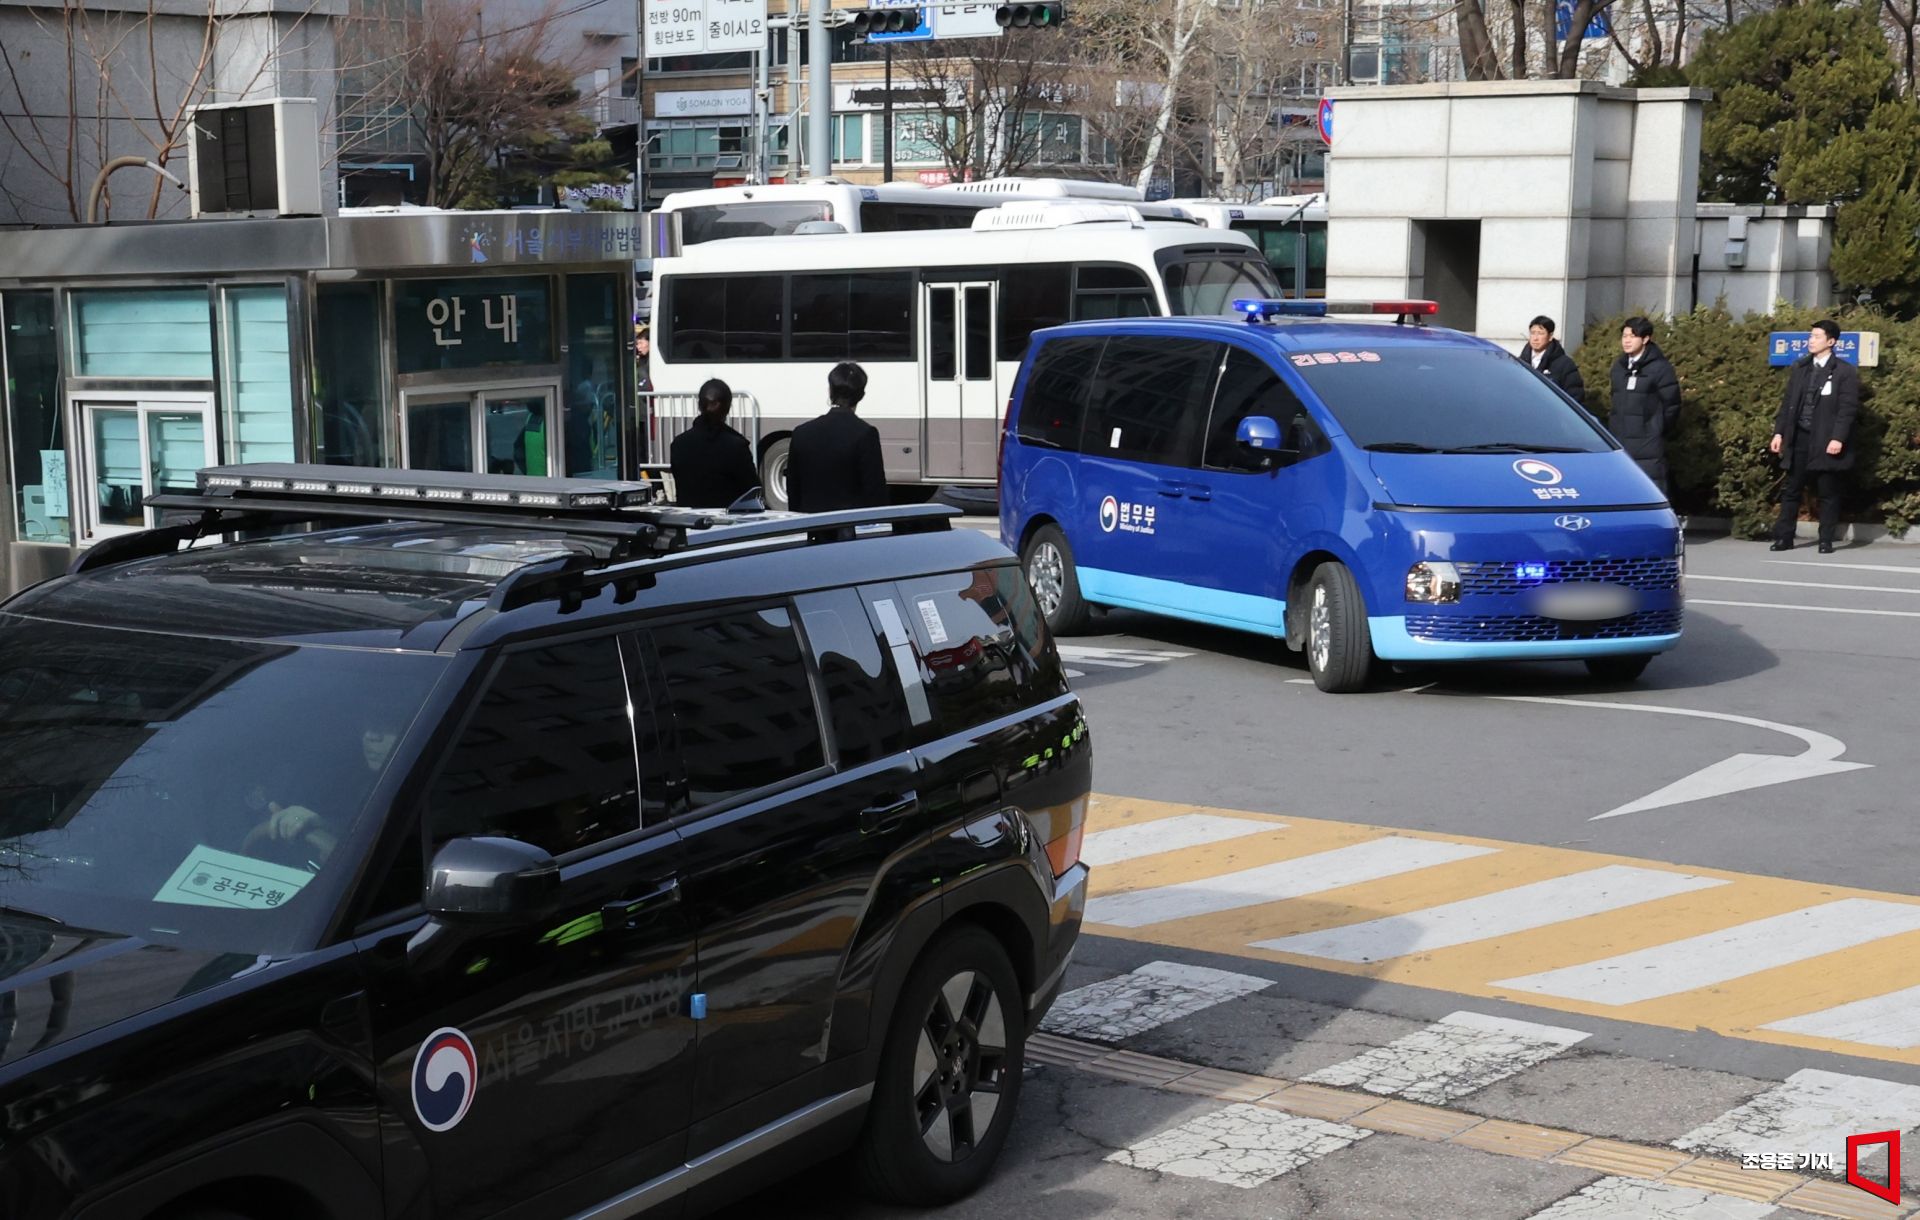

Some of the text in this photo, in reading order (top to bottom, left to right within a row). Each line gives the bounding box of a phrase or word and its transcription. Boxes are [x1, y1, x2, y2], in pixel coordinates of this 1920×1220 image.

[649, 8, 701, 24] 전방 90m
[655, 29, 695, 45] 횡단보도
[709, 19, 762, 39] 줄이시오
[1532, 487, 1580, 499] 법무부
[1120, 502, 1155, 526] 법무부
[213, 876, 286, 907] 공무수행
